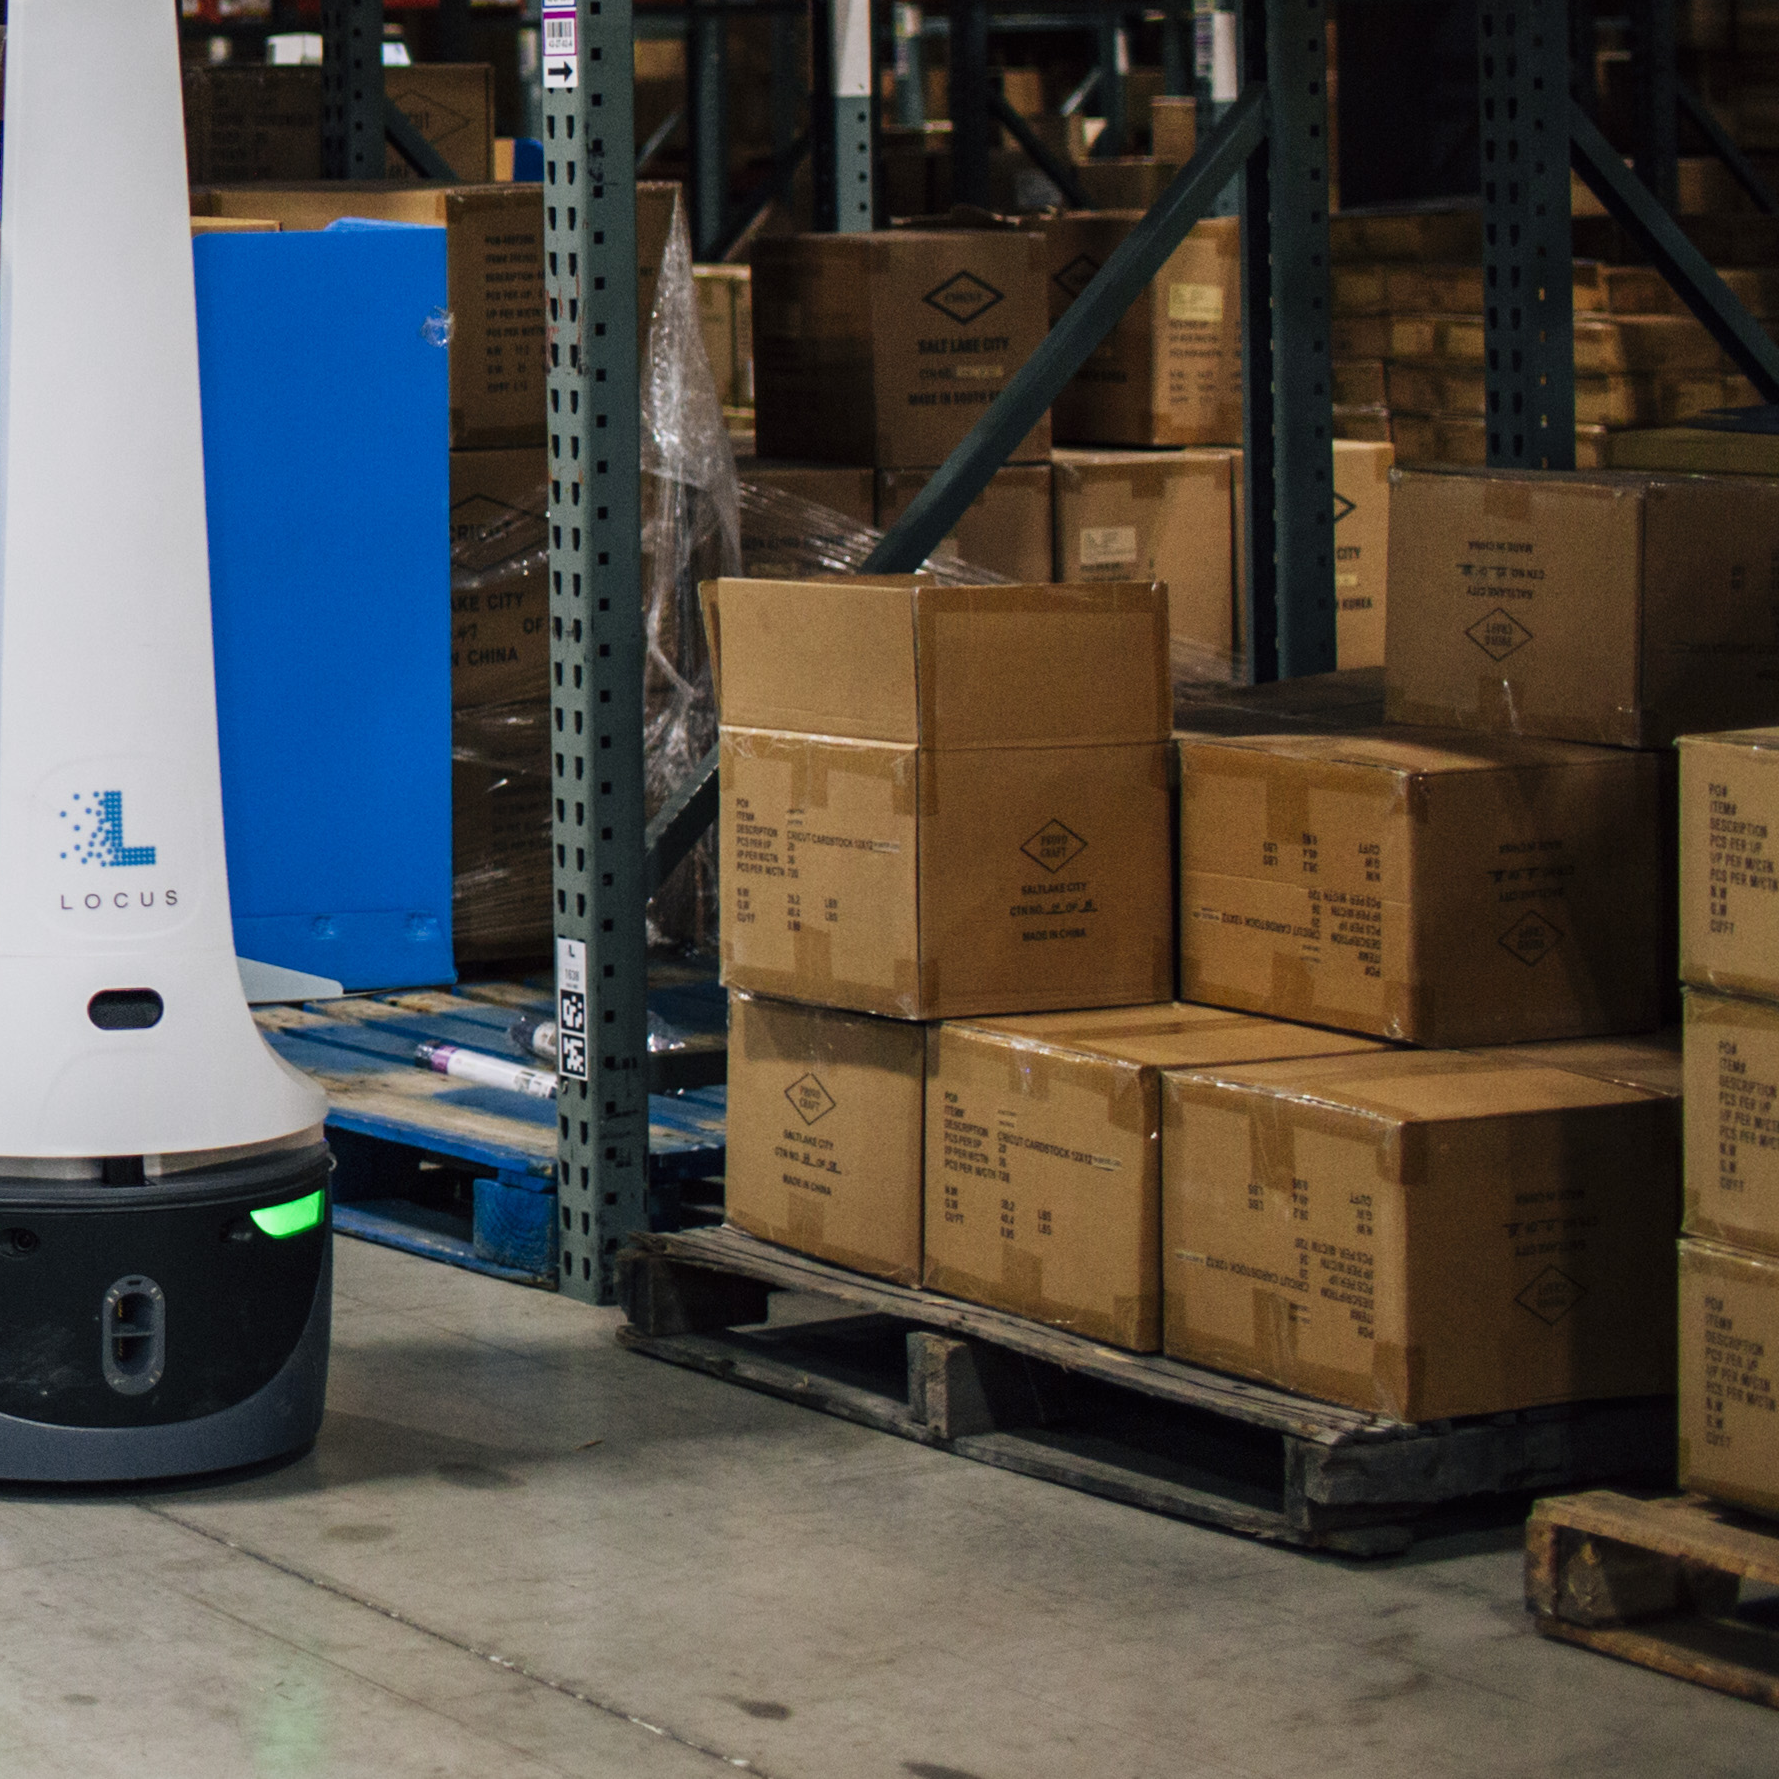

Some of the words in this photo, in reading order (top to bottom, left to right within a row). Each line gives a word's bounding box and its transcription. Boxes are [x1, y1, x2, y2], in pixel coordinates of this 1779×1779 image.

[1337, 547, 1361, 561] CITY
[736, 824, 778, 837] DESCRIPTION
[787, 830, 811, 842] CRICUT
[812, 834, 852, 848] CARDSTOCK
[1710, 817, 1767, 838] DESCRIPTION
[1710, 833, 1727, 849] PCS
[1730, 837, 1746, 851] PER
[1067, 882, 1087, 892] CITY
[60, 889, 178, 911] LOCUS
[945, 1119, 988, 1137] DESCRIPTION
[1025, 1138, 1071, 1159] CARDSTOCK
